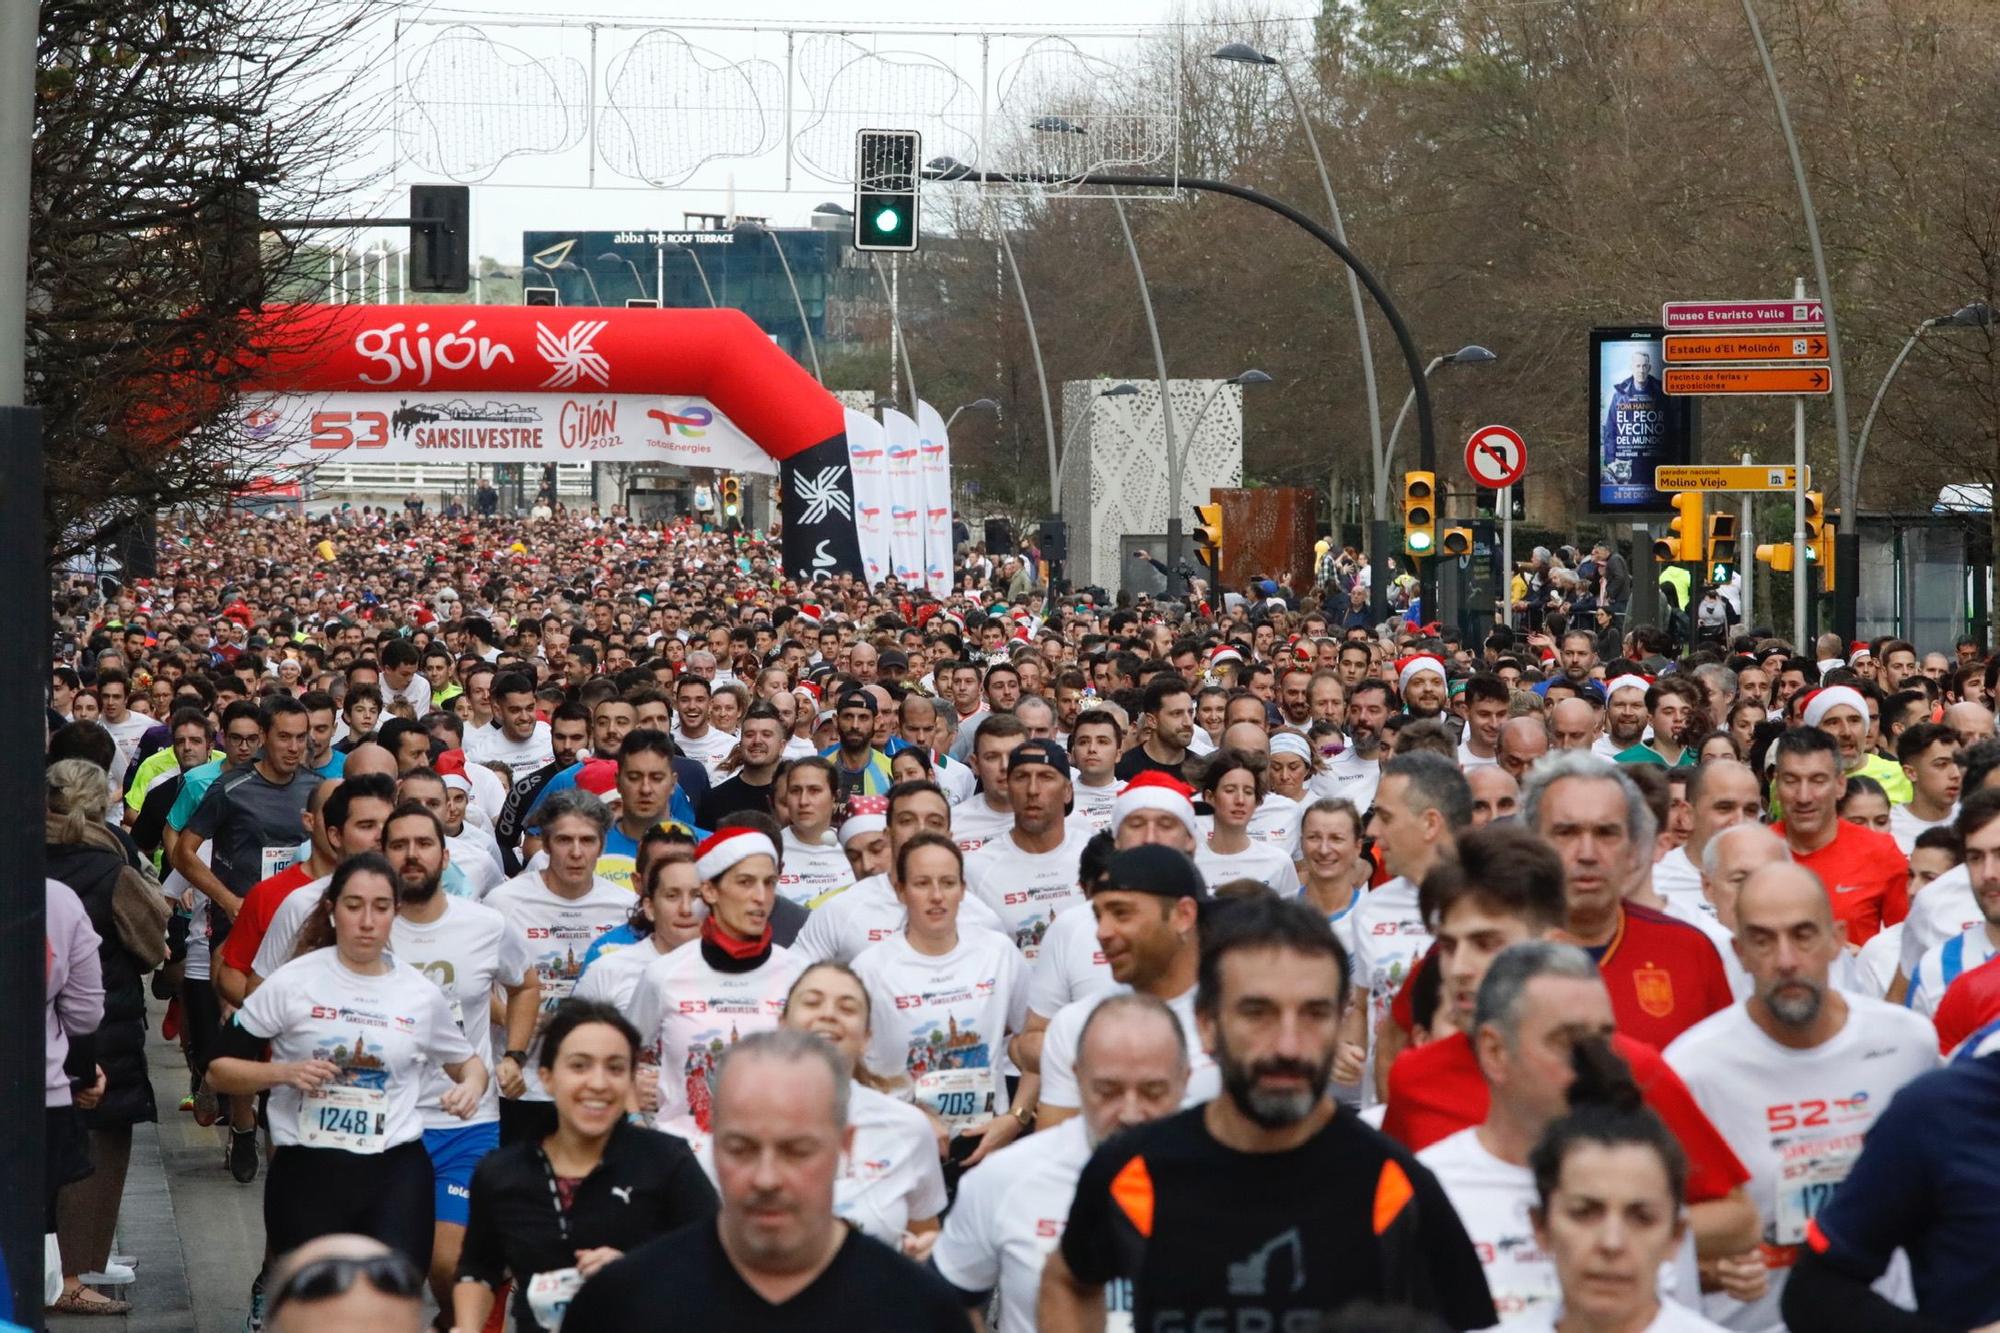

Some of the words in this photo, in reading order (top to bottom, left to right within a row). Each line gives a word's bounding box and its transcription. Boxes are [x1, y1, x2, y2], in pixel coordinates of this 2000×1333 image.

[614, 232, 645, 243] abba
[648, 233, 666, 243] THE
[667, 234, 694, 243] ROOF
[695, 234, 734, 243] TERRACE
[1669, 312, 1704, 321] museo
[1707, 310, 1754, 320] Evaristo
[1757, 309, 1785, 319] Valle
[355, 320, 515, 385] gijón
[1670, 345, 1710, 354] Estadiu
[1738, 344, 1780, 353] Molinón
[1669, 373, 1701, 381] recinto
[1703, 373, 1713, 381] de
[1716, 372, 1742, 381] ferias
[1744, 374, 1749, 382] y
[1669, 382, 1726, 391] exposiciones
[1616, 410, 1629, 423] EL
[1633, 410, 1664, 423] PEOR
[1617, 423, 1664, 435] VECINO
[415, 428, 543, 449] SANSILVESTRE
[590, 436, 624, 450] 2022
[1616, 436, 1630, 445] DEL
[646, 439, 712, 453] TotalEnergies
[1660, 468, 1688, 476] parador
[1690, 467, 1720, 475] nacional
[1660, 478, 1697, 487] Molino
[1700, 478, 1727, 488] Viejo
[500, 775, 542, 836] adidas
[938, 1091, 976, 1116] 703
[319, 1106, 368, 1135] 1248
[1766, 1099, 1830, 1133] 52
